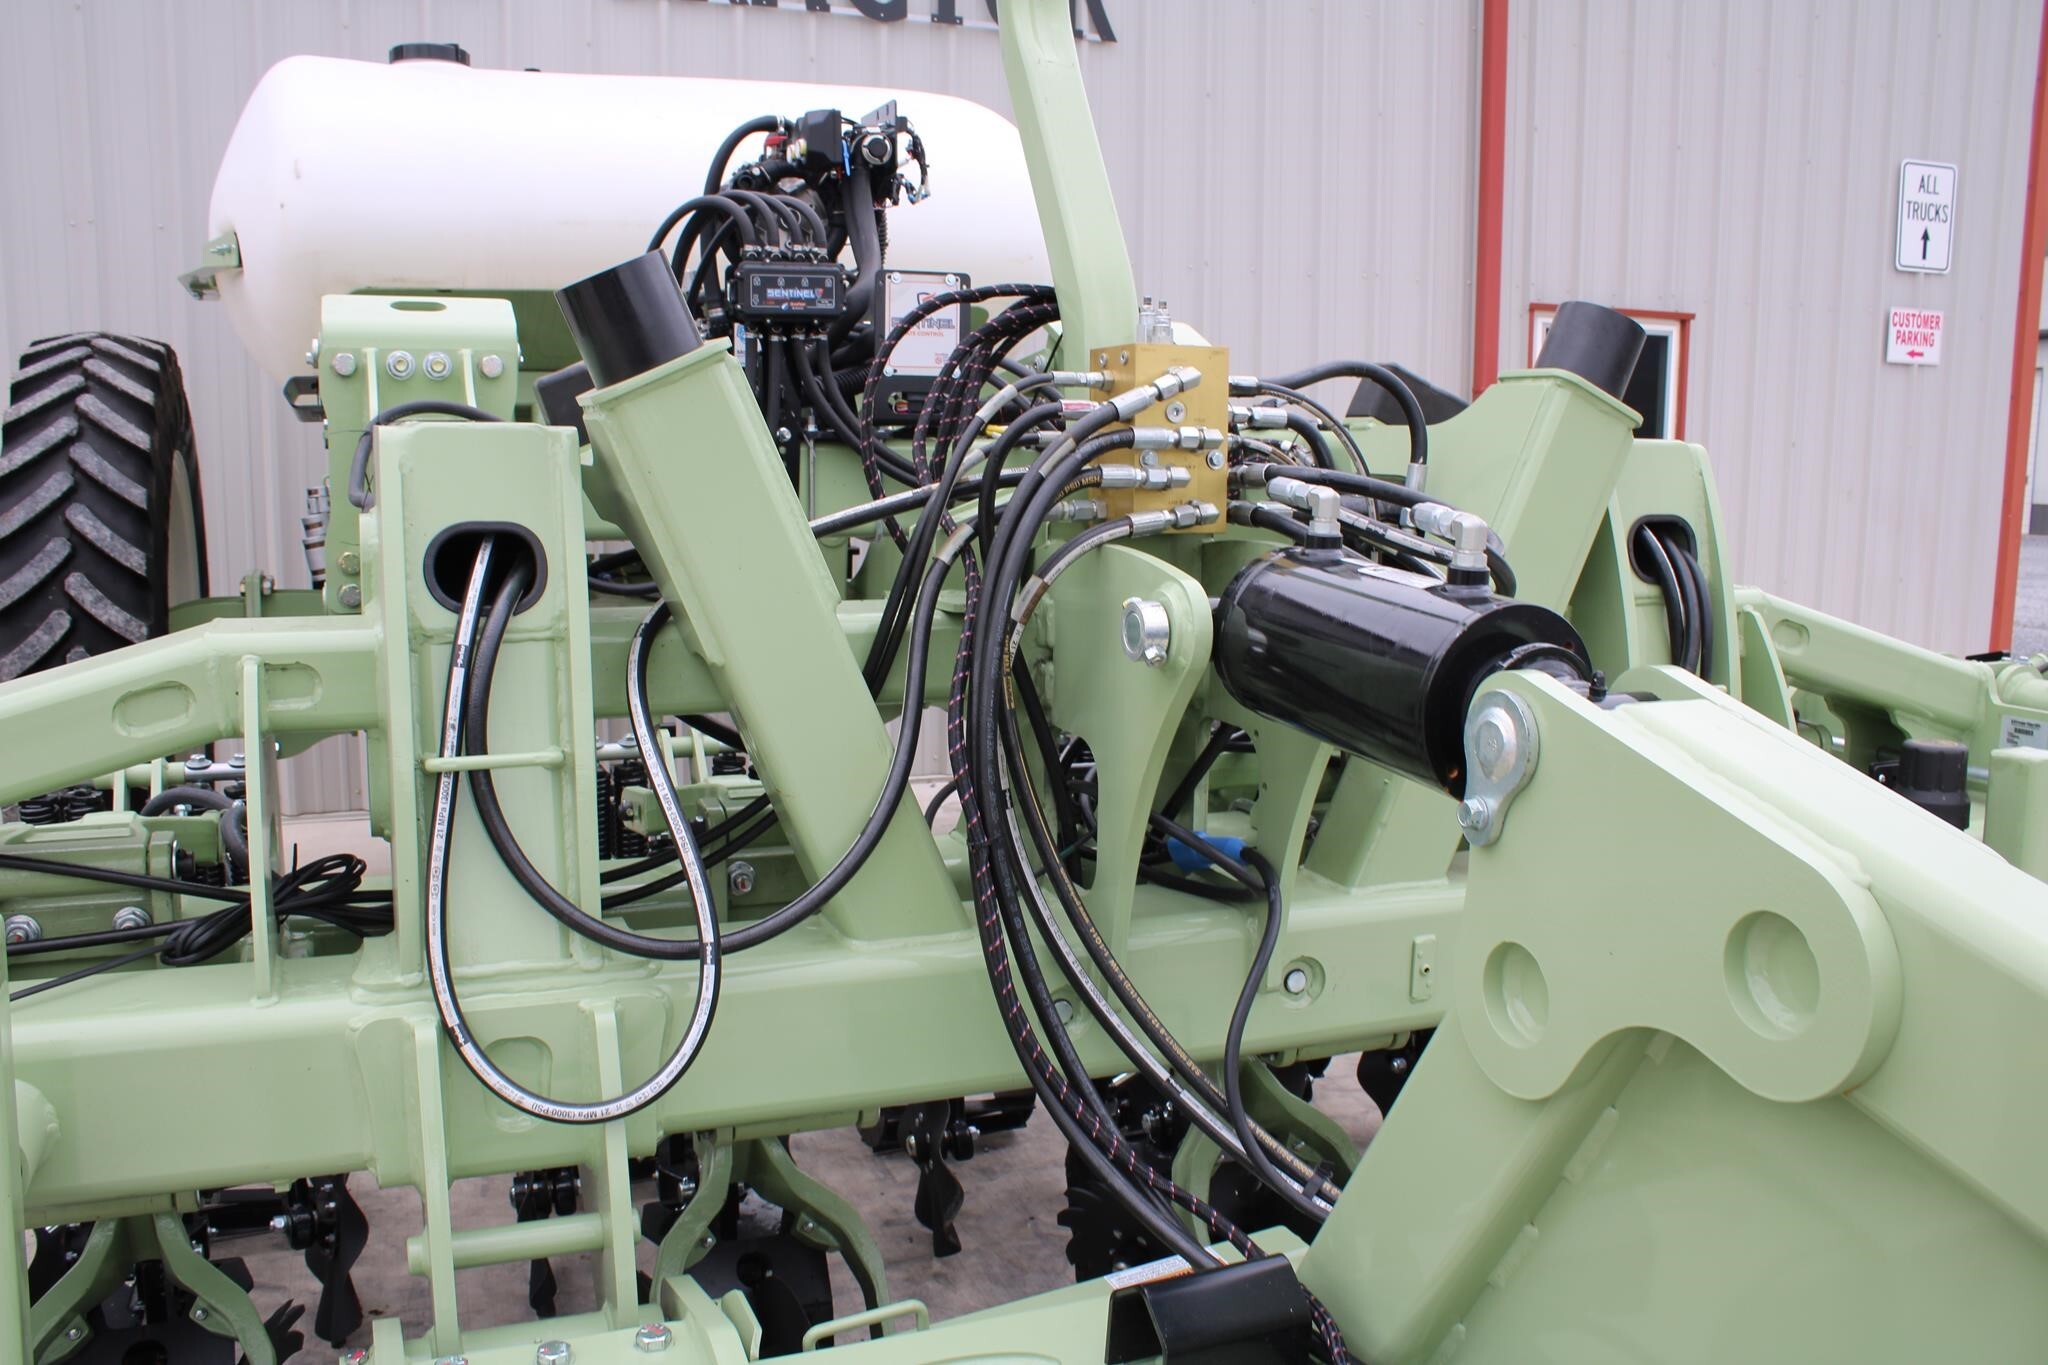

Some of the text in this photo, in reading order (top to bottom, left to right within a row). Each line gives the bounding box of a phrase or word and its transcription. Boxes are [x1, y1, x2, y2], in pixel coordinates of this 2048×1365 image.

[1918, 174, 1940, 195] ALL
[1906, 200, 1950, 223] TRUCKS
[766, 287, 816, 300] SENTINEL
[1891, 311, 1941, 330] CUSTOMER
[1895, 329, 1935, 347] PARKING
[657, 781, 666, 792] 21
[662, 793, 673, 811] MPa
[438, 807, 447, 827] MPa
[436, 829, 444, 839] 21
[551, 1110, 575, 1120] (3000
[578, 1111, 598, 1120] MPa
[600, 1109, 611, 1117] 21
